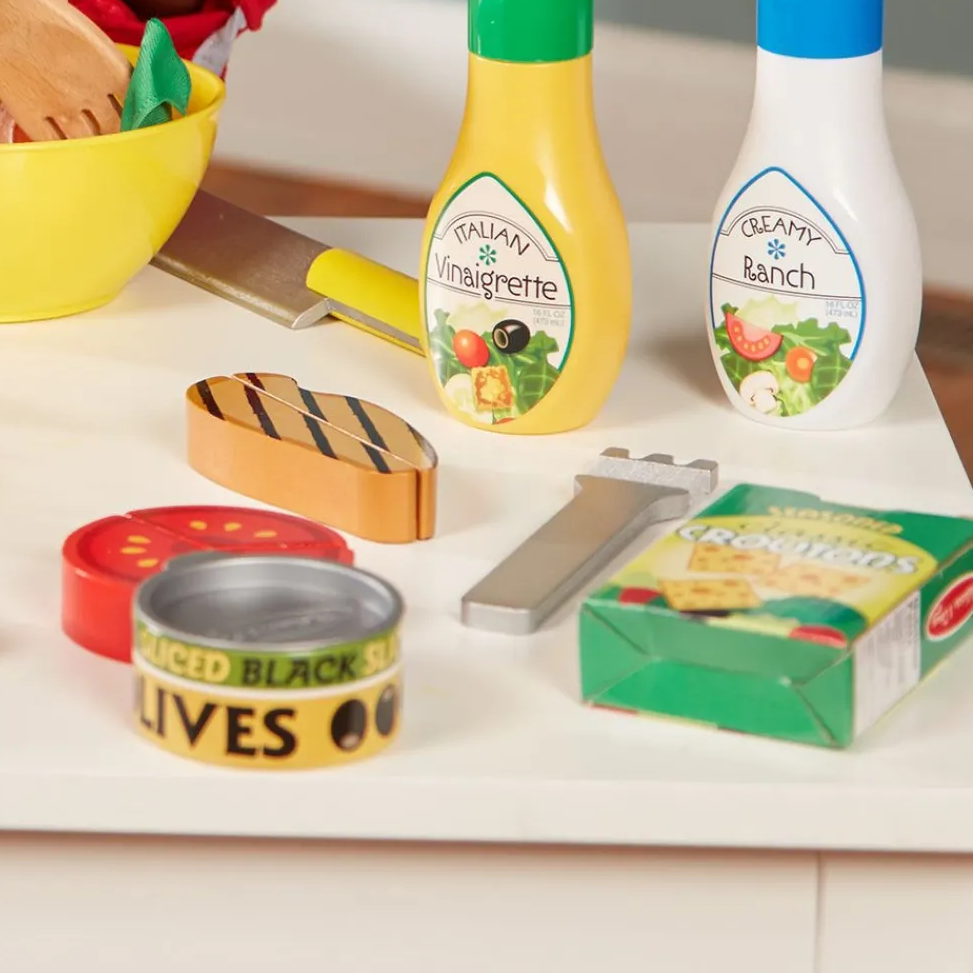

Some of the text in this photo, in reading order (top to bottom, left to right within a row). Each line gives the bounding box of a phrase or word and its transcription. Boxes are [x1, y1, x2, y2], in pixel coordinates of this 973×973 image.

[454, 221, 530, 256] ITALIAN
[741, 215, 822, 246] CREAMY
[434, 252, 558, 300] Vinaigrette
[744, 255, 815, 289] Ranch
[241, 651, 357, 687] BLACK
[139, 676, 298, 758] LIVES
